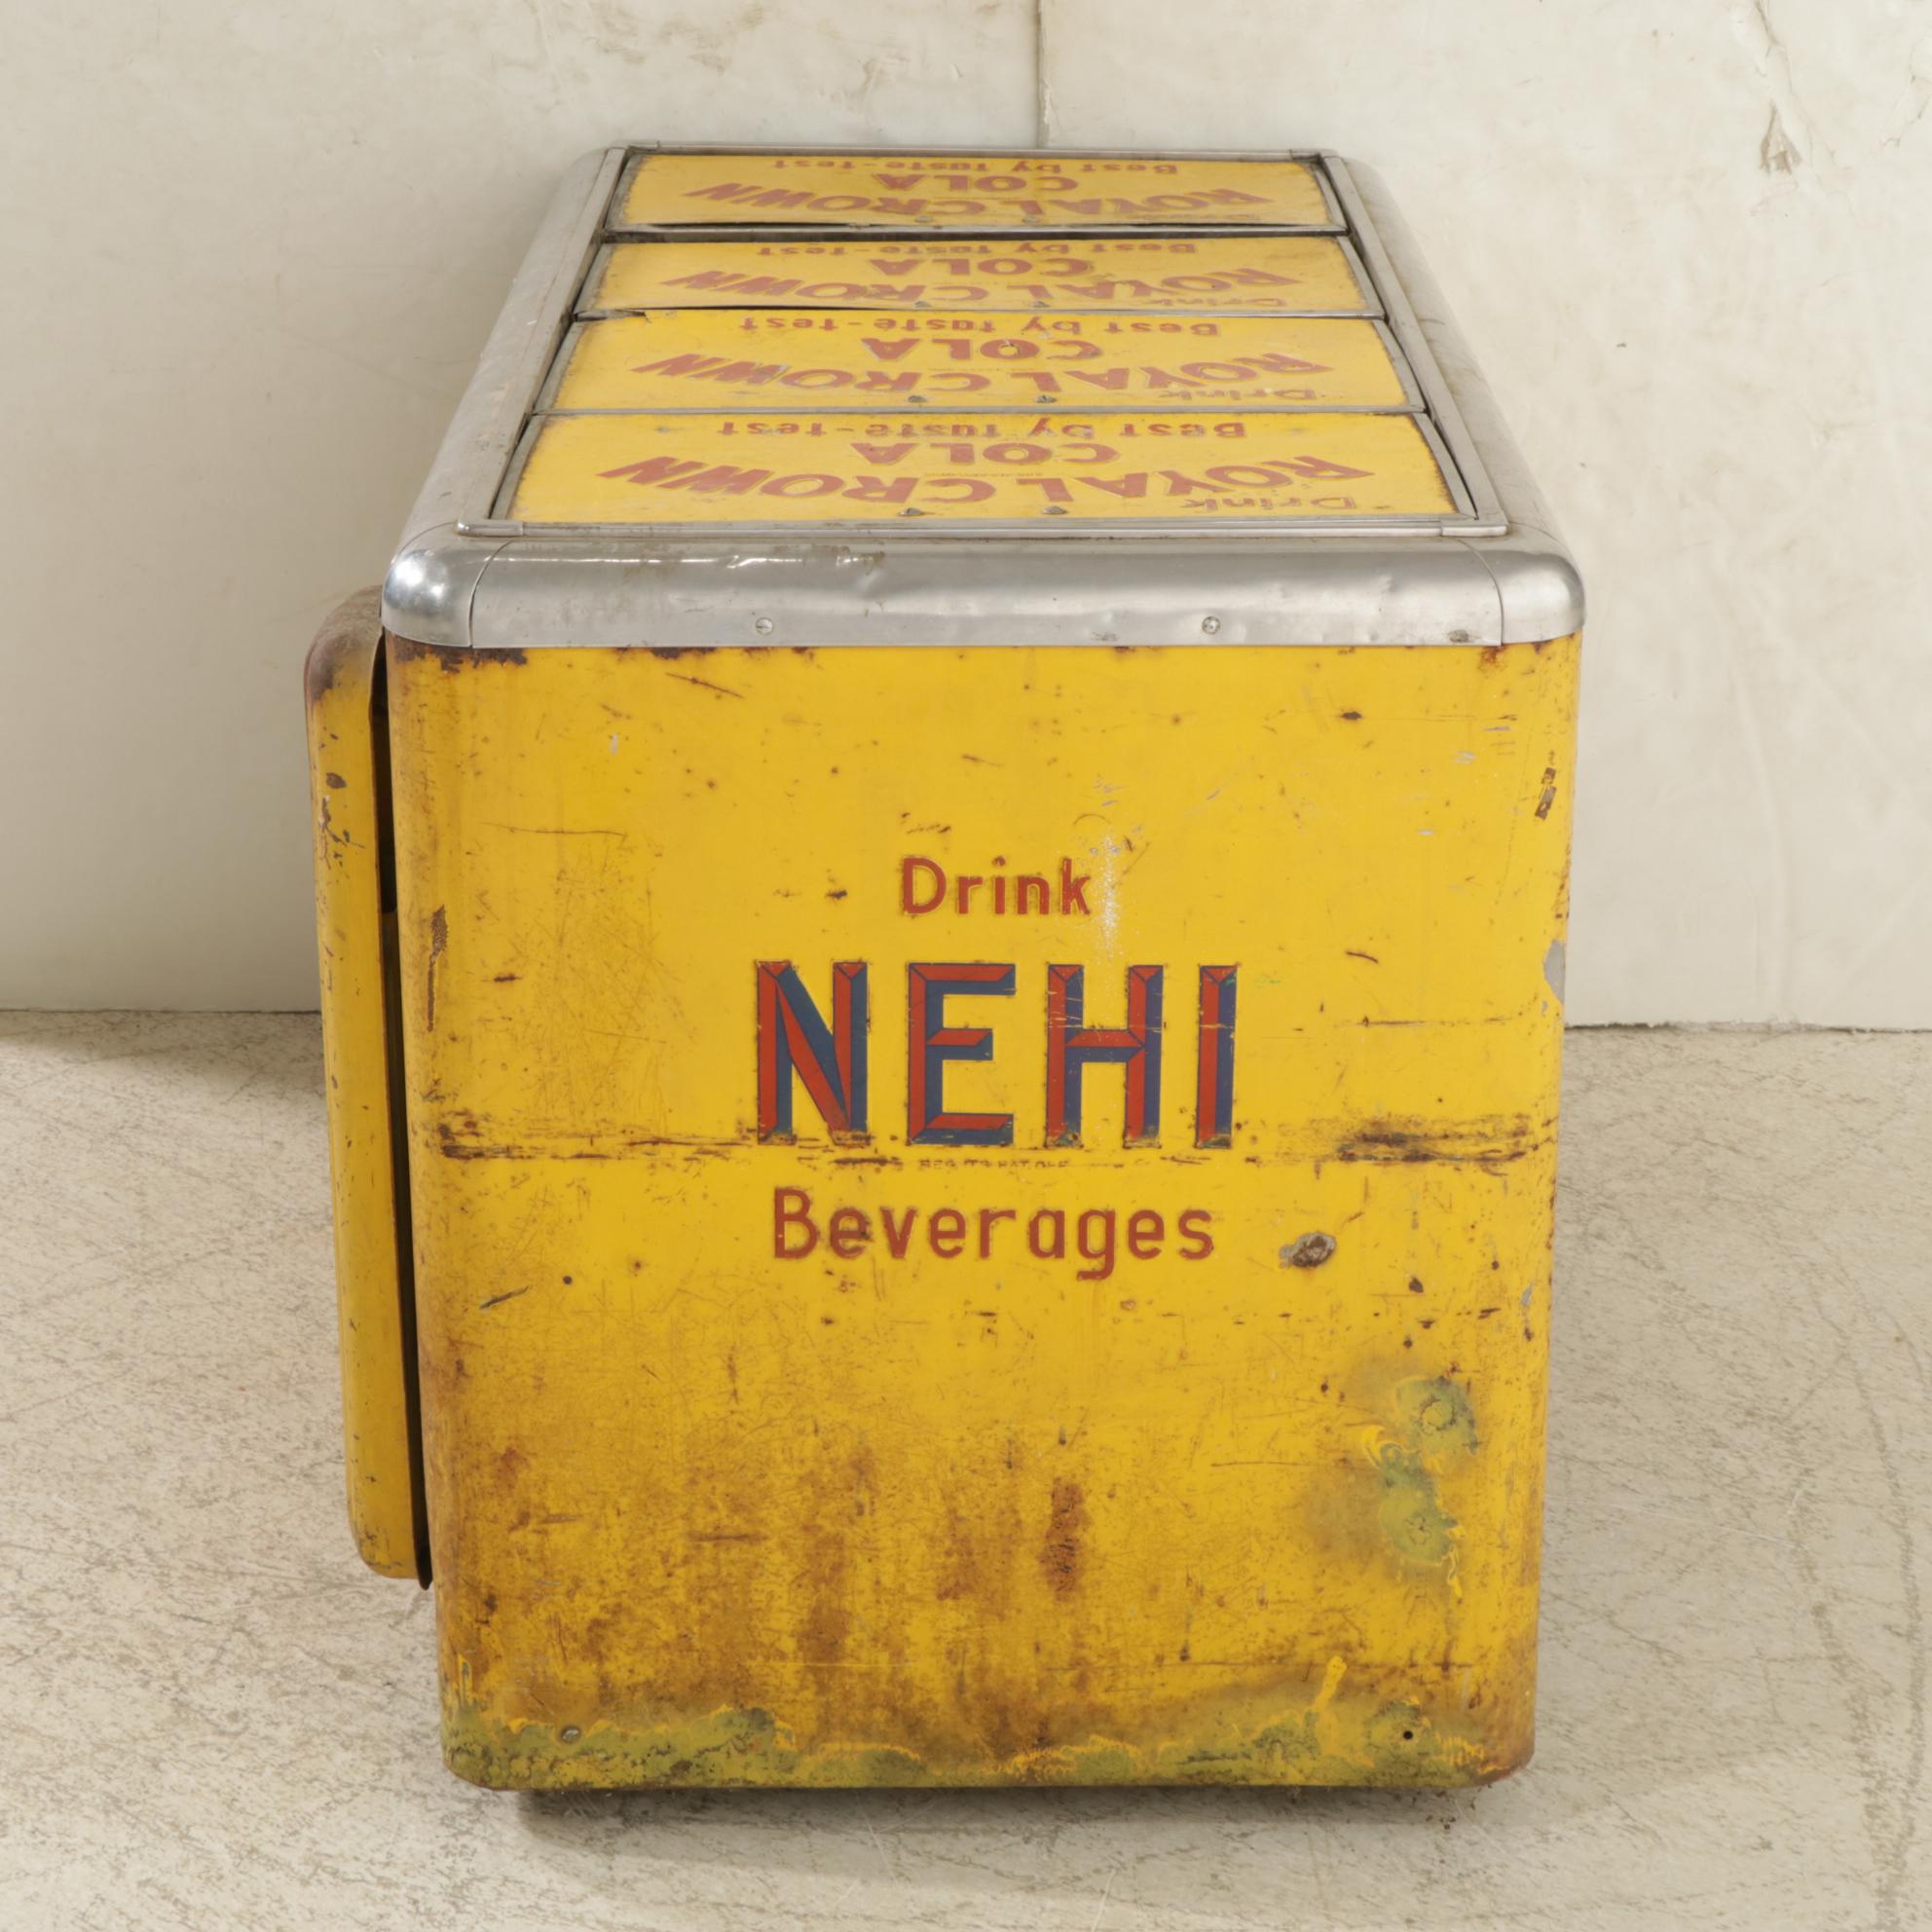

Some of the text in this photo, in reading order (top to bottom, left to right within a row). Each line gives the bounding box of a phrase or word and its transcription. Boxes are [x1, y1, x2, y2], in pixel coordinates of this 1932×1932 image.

[1012, 161, 1061, 173] by
[1081, 164, 1177, 173] Best
[871, 173, 1078, 192] COLA
[682, 182, 1275, 215] ROYAL CROWN
[1015, 242, 1070, 253] by
[1091, 243, 1197, 253] Best
[869, 257, 1089, 277] COLA
[658, 267, 1303, 301] ROYAL CROWN
[1022, 316, 1081, 334] by
[1104, 322, 1218, 336] Best
[861, 338, 1103, 360] COLA
[630, 353, 1334, 391] ROYAL CROWN
[1159, 389, 1317, 400] Drink
[1027, 418, 1095, 438] by
[1119, 423, 1246, 437] Best
[851, 442, 1119, 464] COLA
[595, 455, 1375, 502] ROYAL CROWN
[1181, 497, 1356, 510] Drink
[901, 857, 1091, 916] Drink
[755, 959, 1238, 1149] NEHI
[774, 1187, 1215, 1281] Beverages
